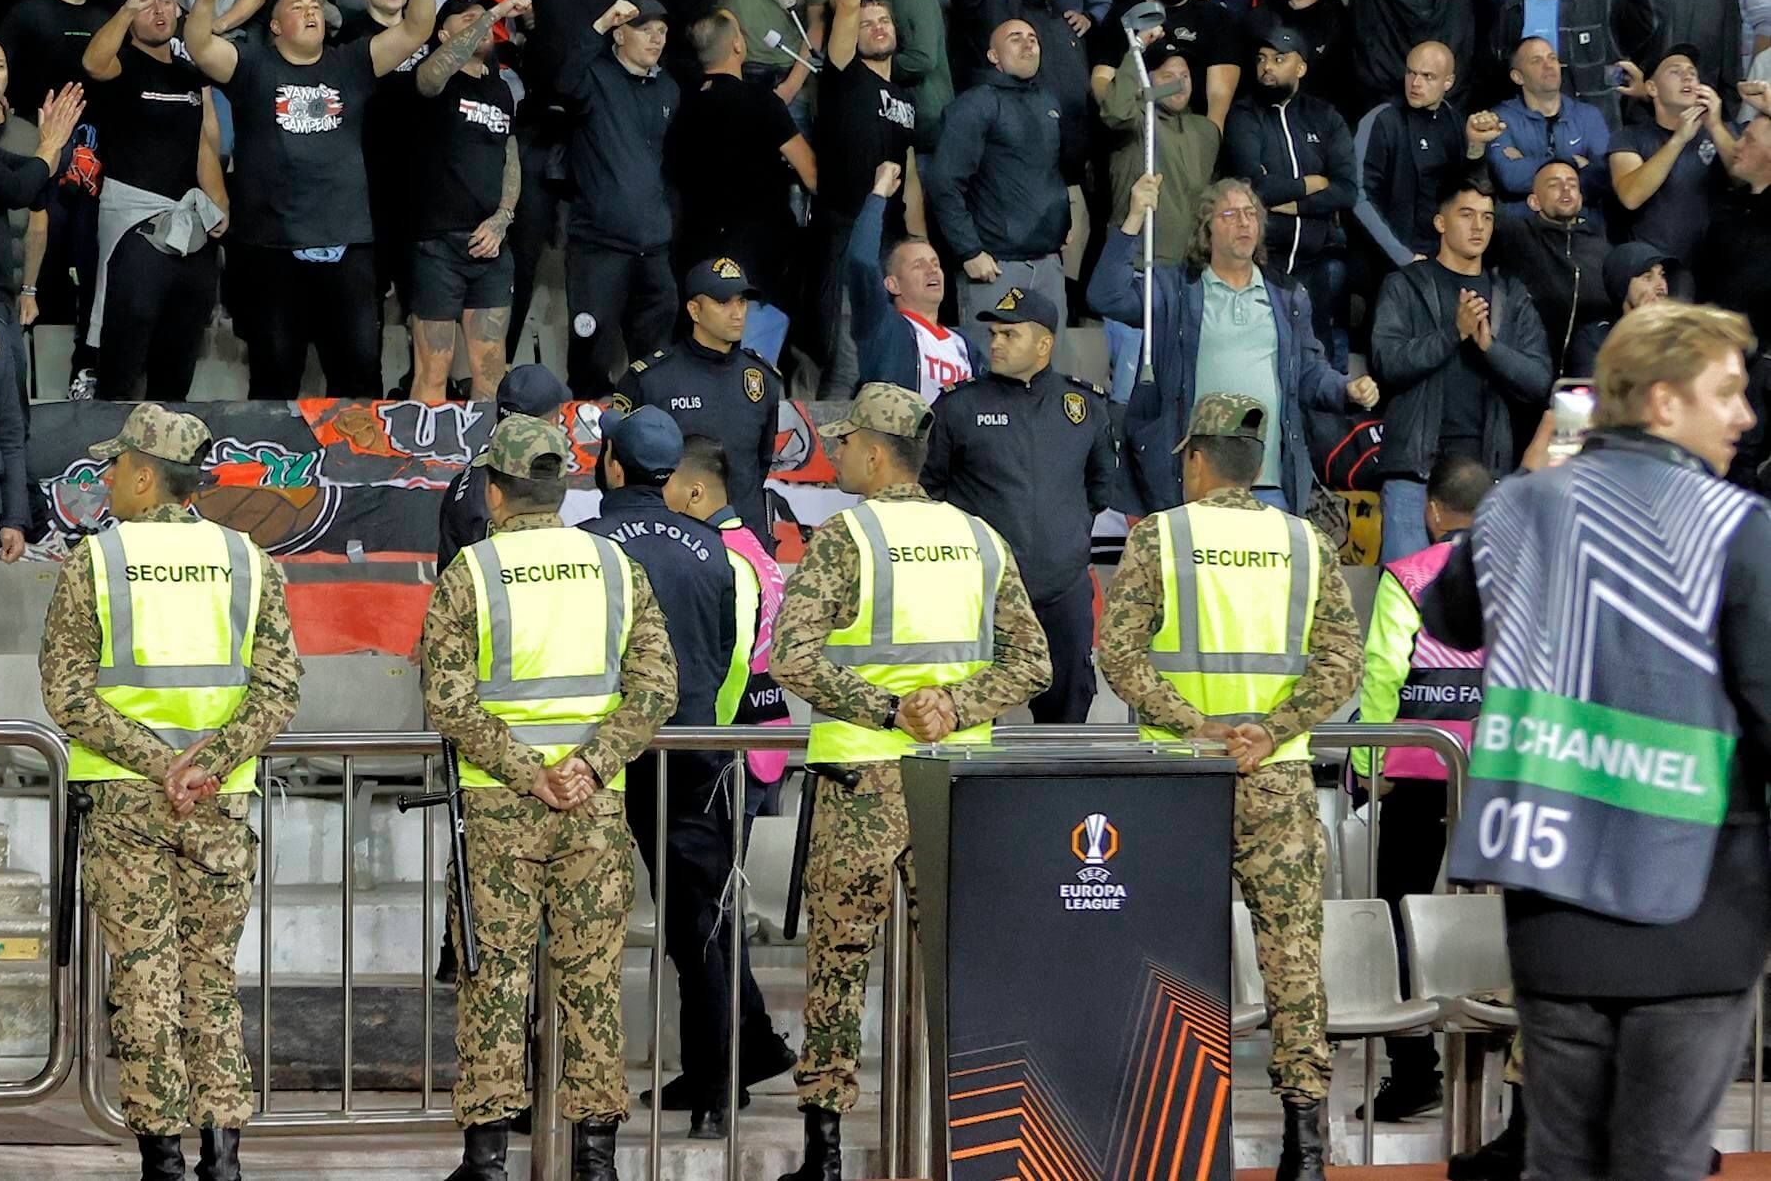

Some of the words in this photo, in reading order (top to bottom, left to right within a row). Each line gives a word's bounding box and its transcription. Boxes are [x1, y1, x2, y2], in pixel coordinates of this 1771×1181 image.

[887, 546, 982, 562] SECURITY
[1192, 549, 1292, 569] SECURITY
[125, 565, 234, 583] SECURITY
[498, 564, 603, 585] SECURITY
[1400, 687, 1456, 703] SITING
[1514, 716, 1706, 795] CHANNEL
[1480, 796, 1572, 869] 015
[1078, 869, 1108, 882] UEFA
[1060, 884, 1126, 900] EUROPA
[1065, 898, 1121, 911] LEAGUE
